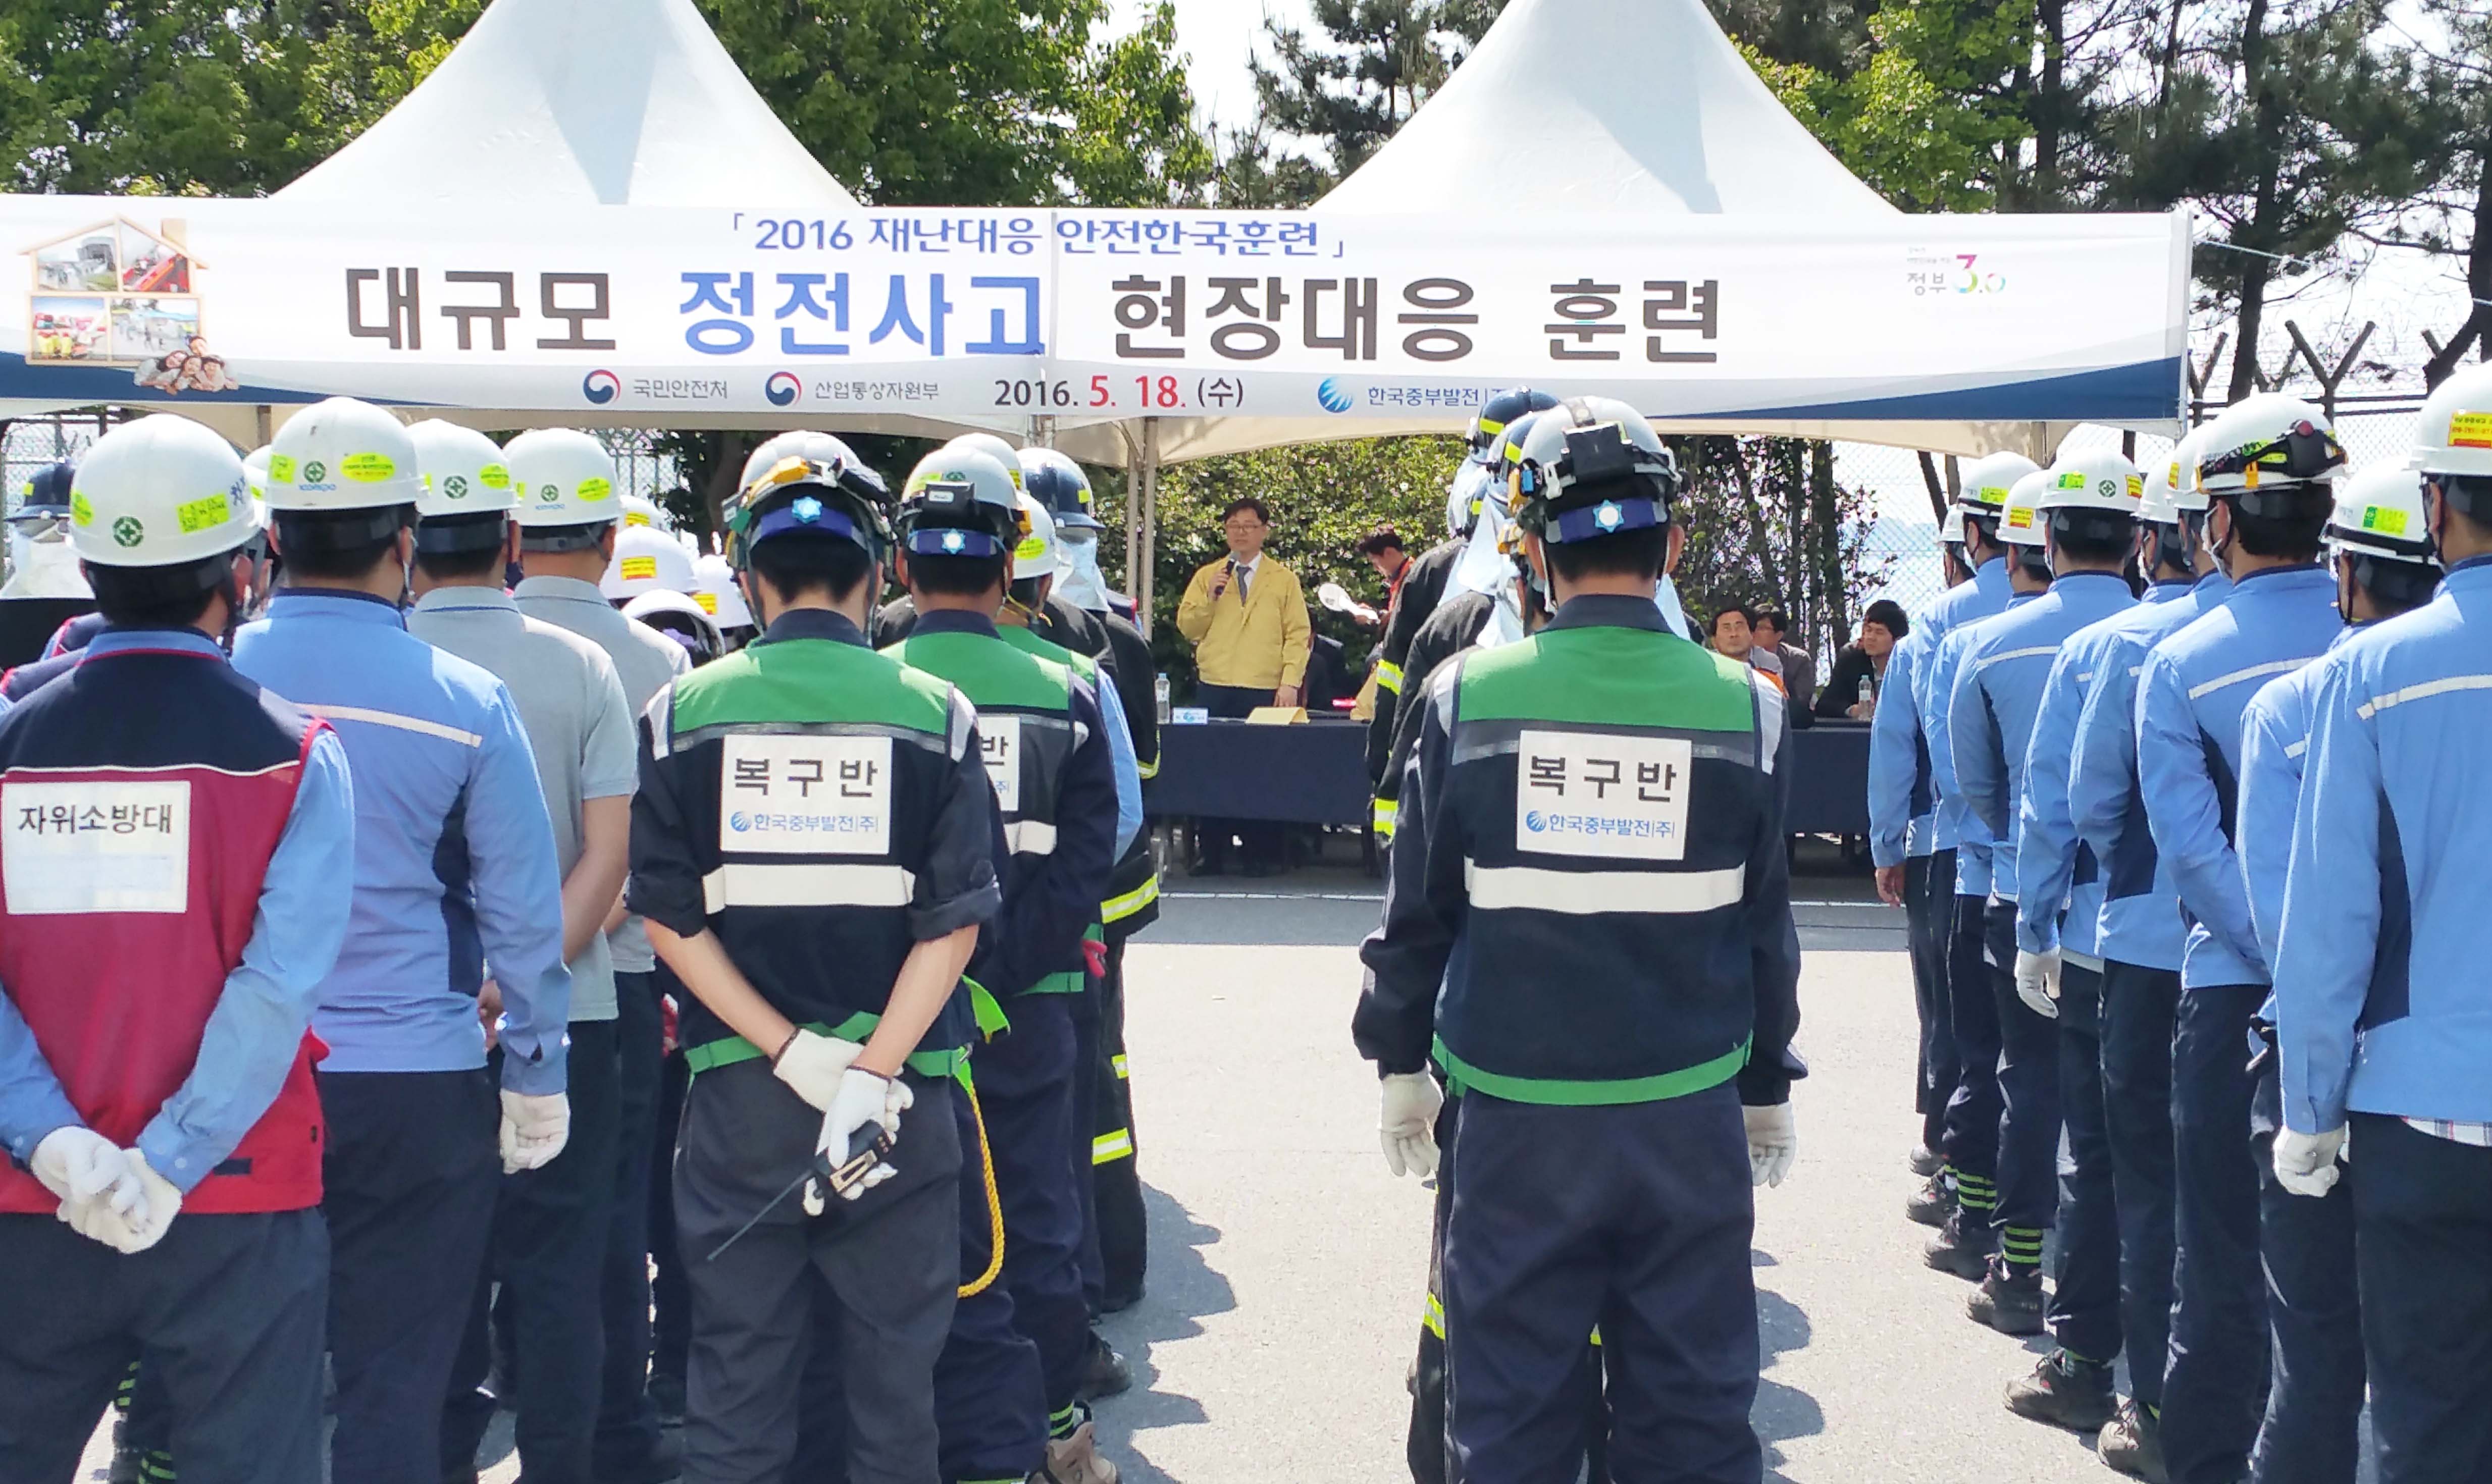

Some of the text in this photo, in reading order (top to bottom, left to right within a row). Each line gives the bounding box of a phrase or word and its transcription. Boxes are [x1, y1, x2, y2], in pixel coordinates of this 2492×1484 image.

[868, 218, 1042, 255] 재난대응
[345, 267, 1719, 363] 대규모 정전사고 현장대응 훈련
[634, 379, 728, 399] 국민안전처
[815, 381, 939, 400] 산업통상자원부
[995, 375, 1244, 408] 2016. 5. 18. (수)
[17, 804, 172, 835] 자위소방대
